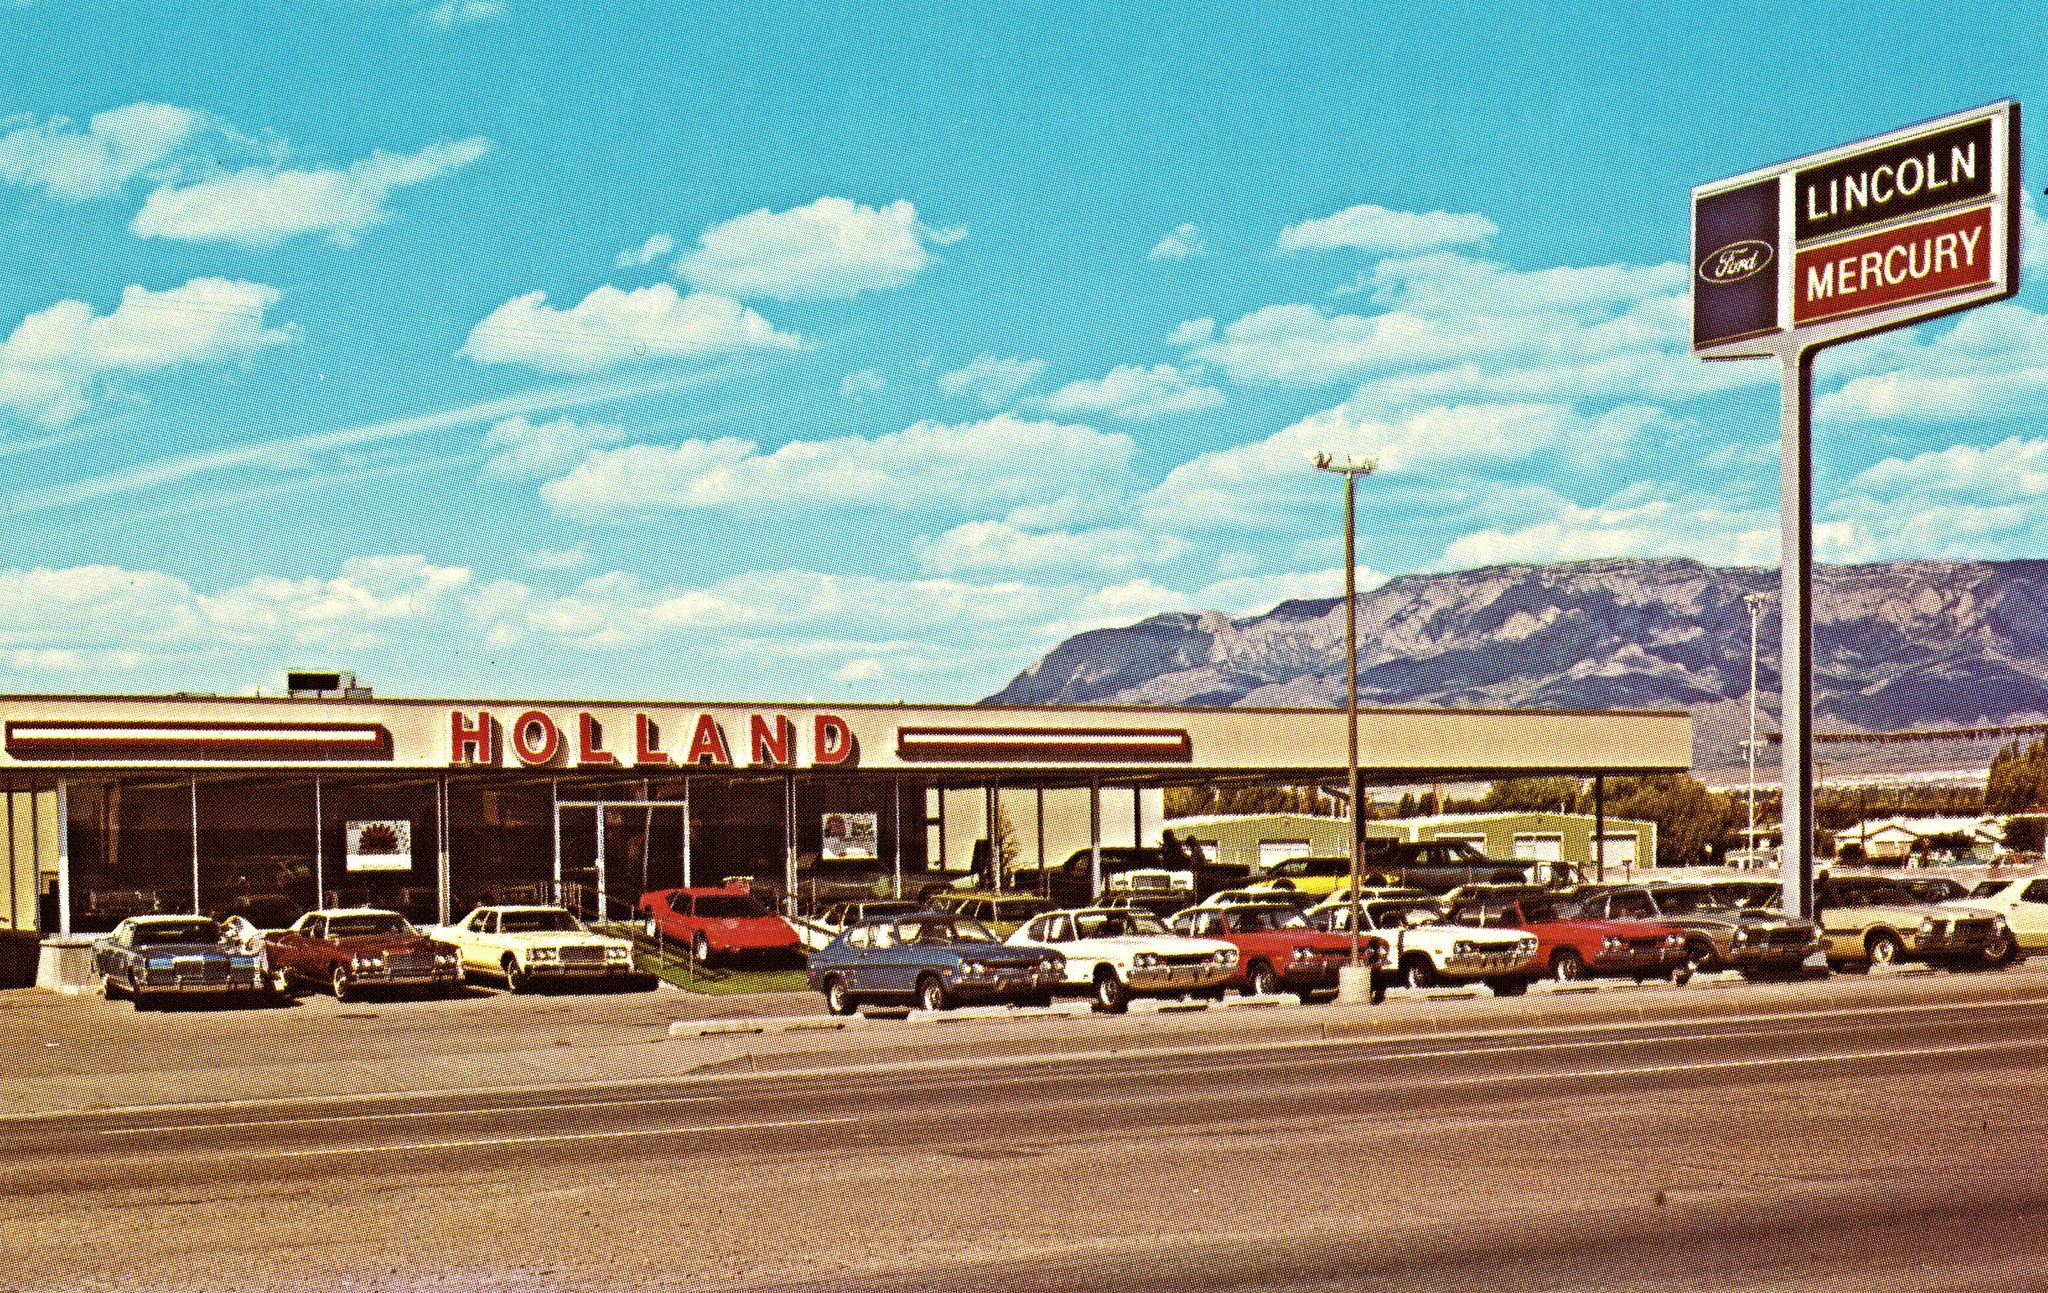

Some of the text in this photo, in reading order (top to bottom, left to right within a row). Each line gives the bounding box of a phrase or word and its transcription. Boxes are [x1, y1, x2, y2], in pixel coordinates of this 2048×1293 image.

[1808, 142, 1976, 221] LINCOLN
[1715, 246, 1759, 279] Ford
[1807, 227, 1982, 302] MERCURY
[450, 710, 854, 765] HOLLAND
